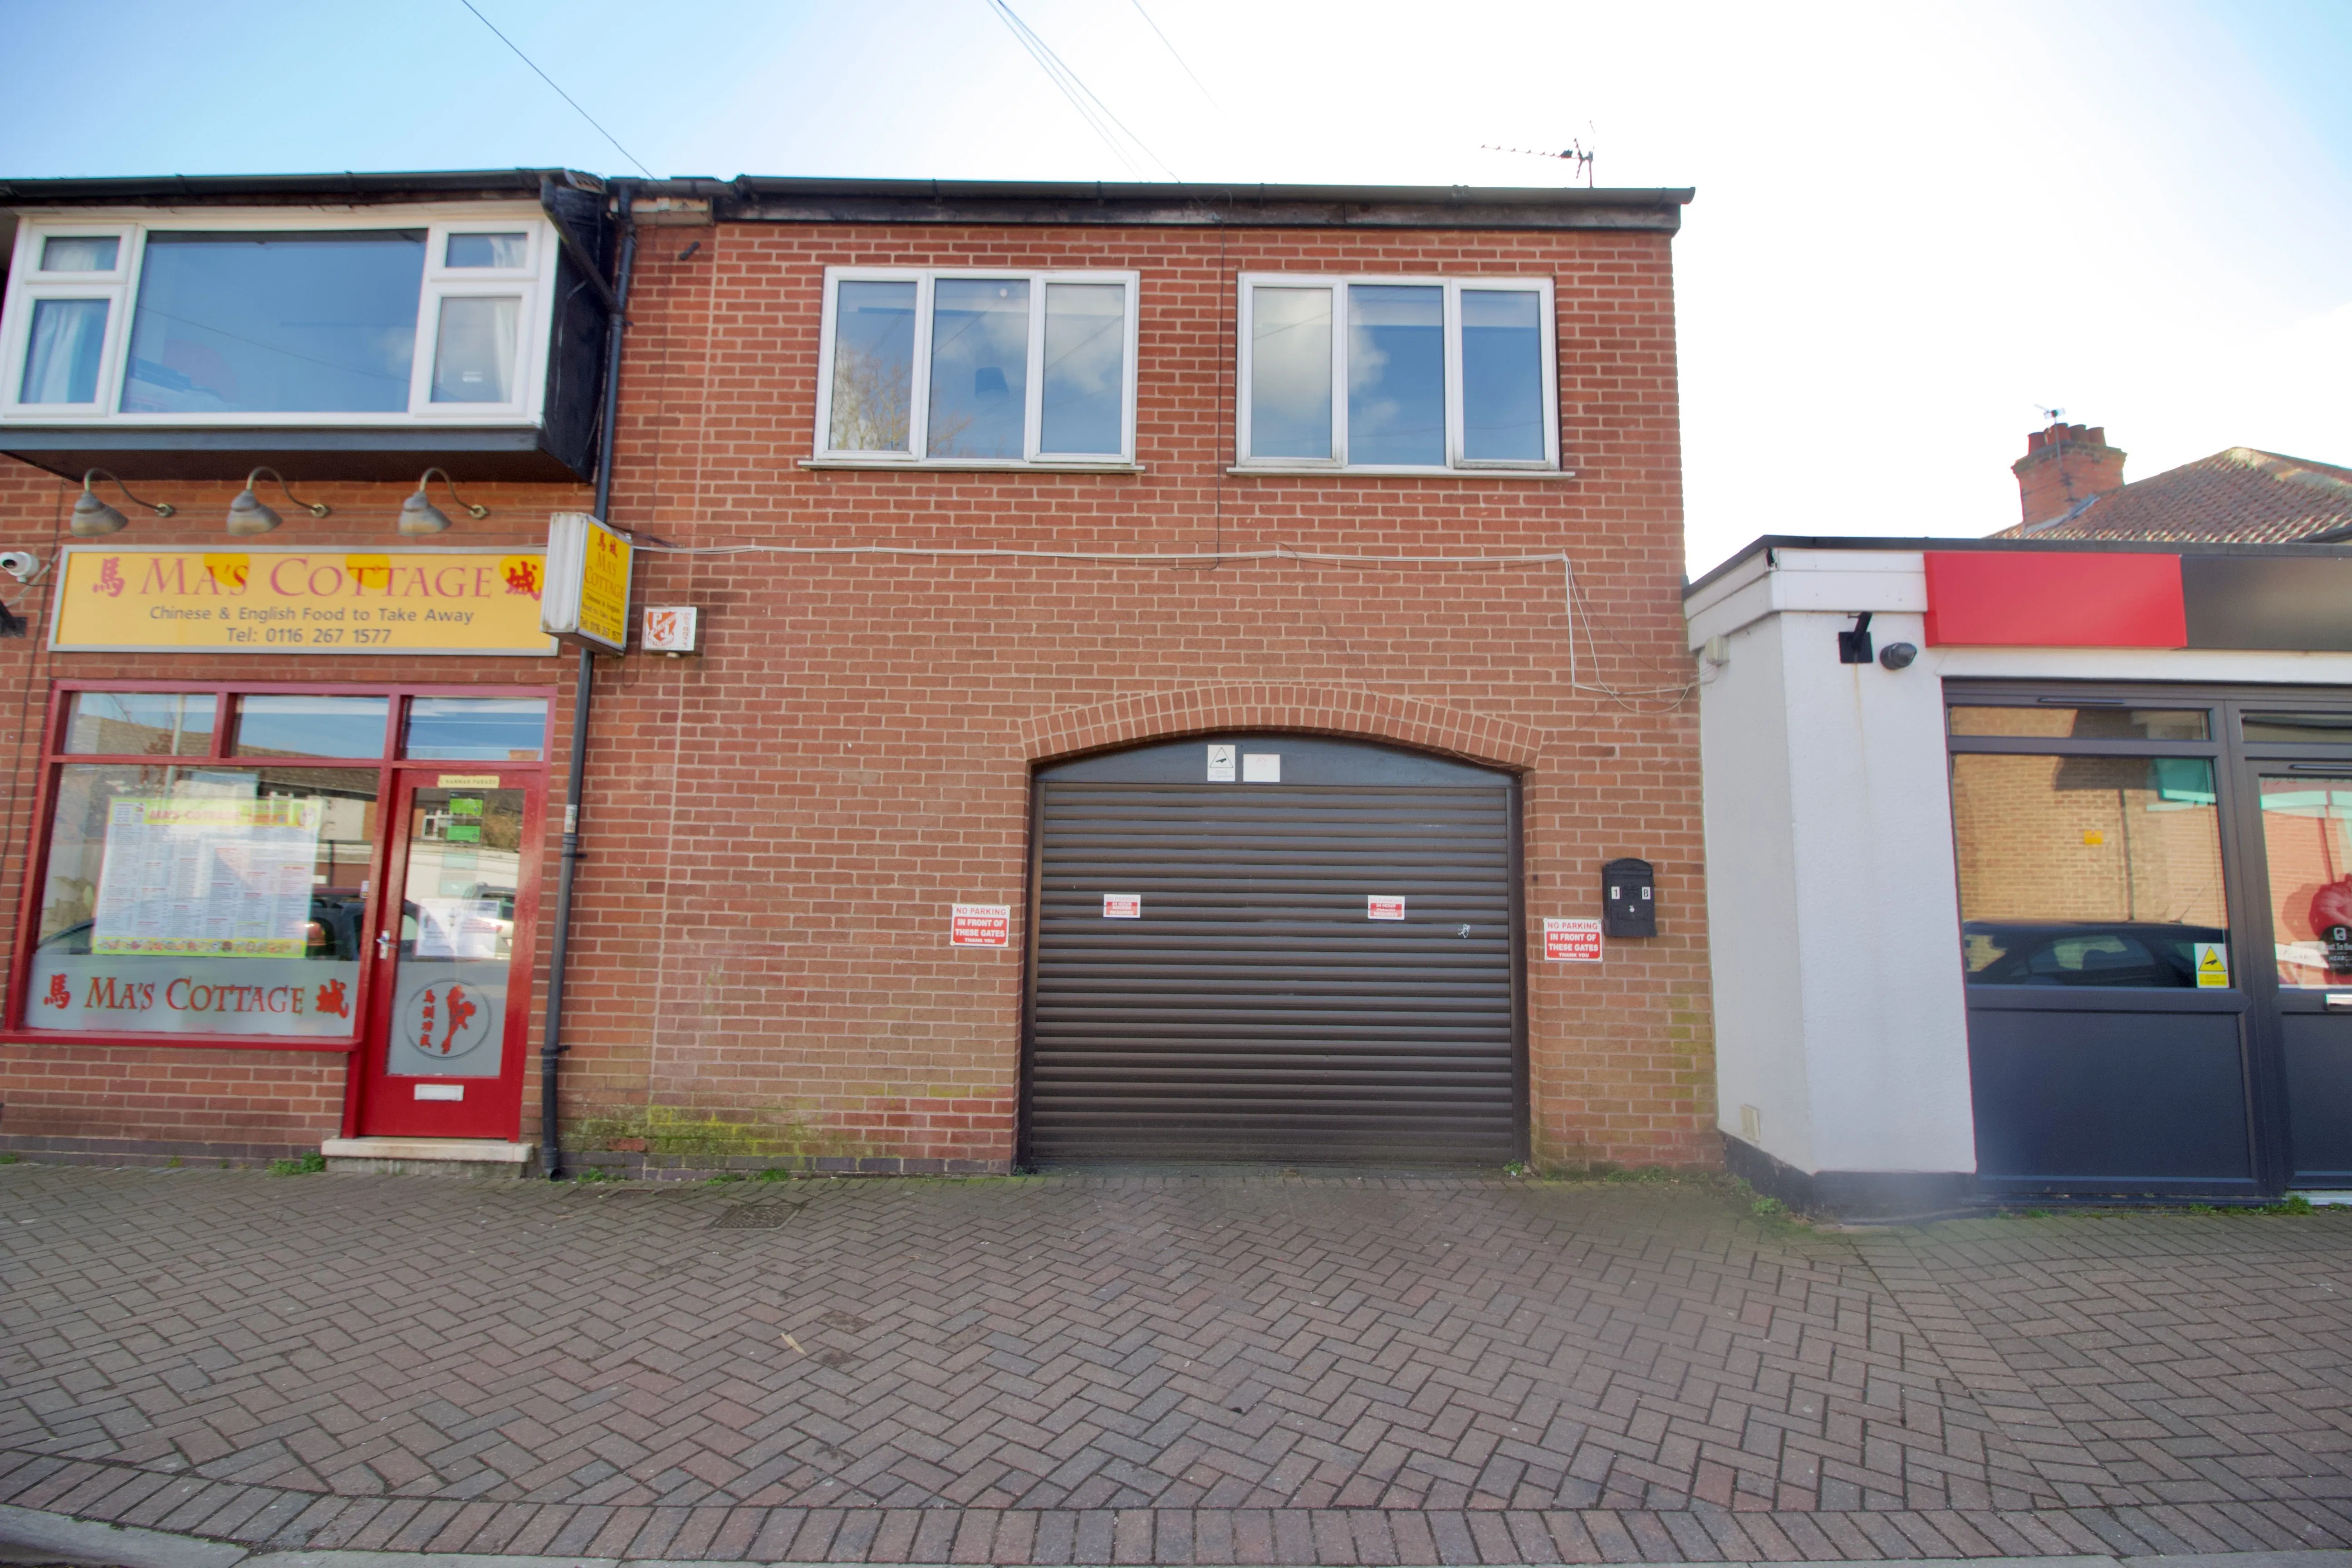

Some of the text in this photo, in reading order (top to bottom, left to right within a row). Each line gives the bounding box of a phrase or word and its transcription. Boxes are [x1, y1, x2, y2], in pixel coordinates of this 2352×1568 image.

[92, 557, 125, 598] 馬
[270, 555, 493, 598] COTTAGE
[150, 606, 474, 625] Chinese & English Food to Take Away
[227, 627, 391, 643] Tel: 0116 267 1577
[967, 919, 992, 927] FRONT
[955, 928, 1005, 937] THESE GATES
[1586, 934, 1597, 942] OF
[1574, 944, 1598, 952] GATES
[43, 973, 71, 1009] 馬
[84, 976, 304, 1015] MA'S COTTAGE
